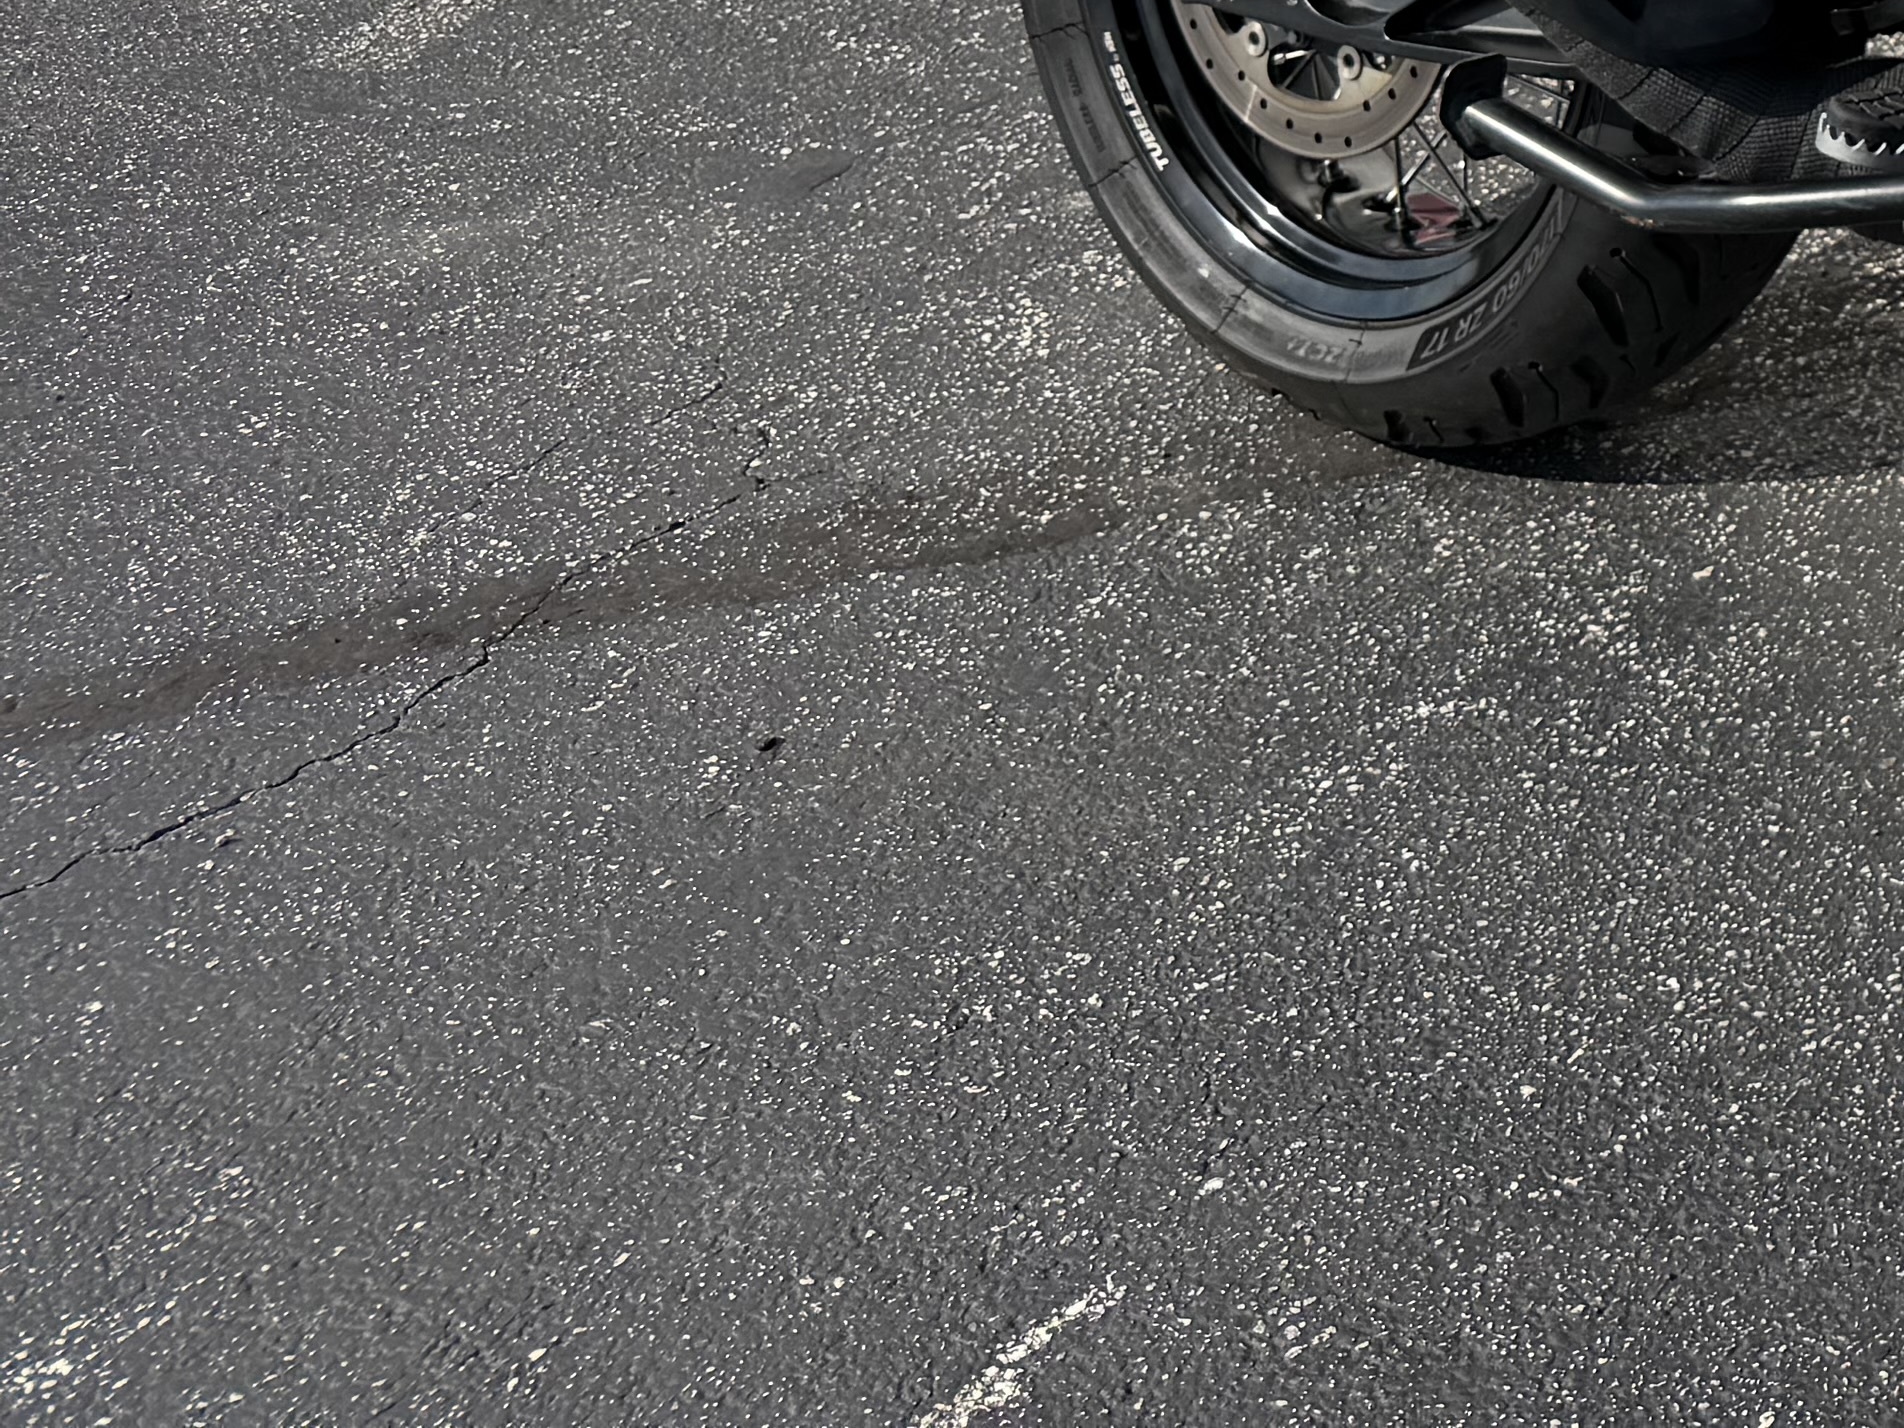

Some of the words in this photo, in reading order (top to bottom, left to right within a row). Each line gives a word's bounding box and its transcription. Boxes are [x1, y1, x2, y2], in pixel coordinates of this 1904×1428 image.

[1109, 63, 1170, 172] TUBELESS
[1420, 326, 1450, 360] 17
[1454, 301, 1489, 343] ZR
